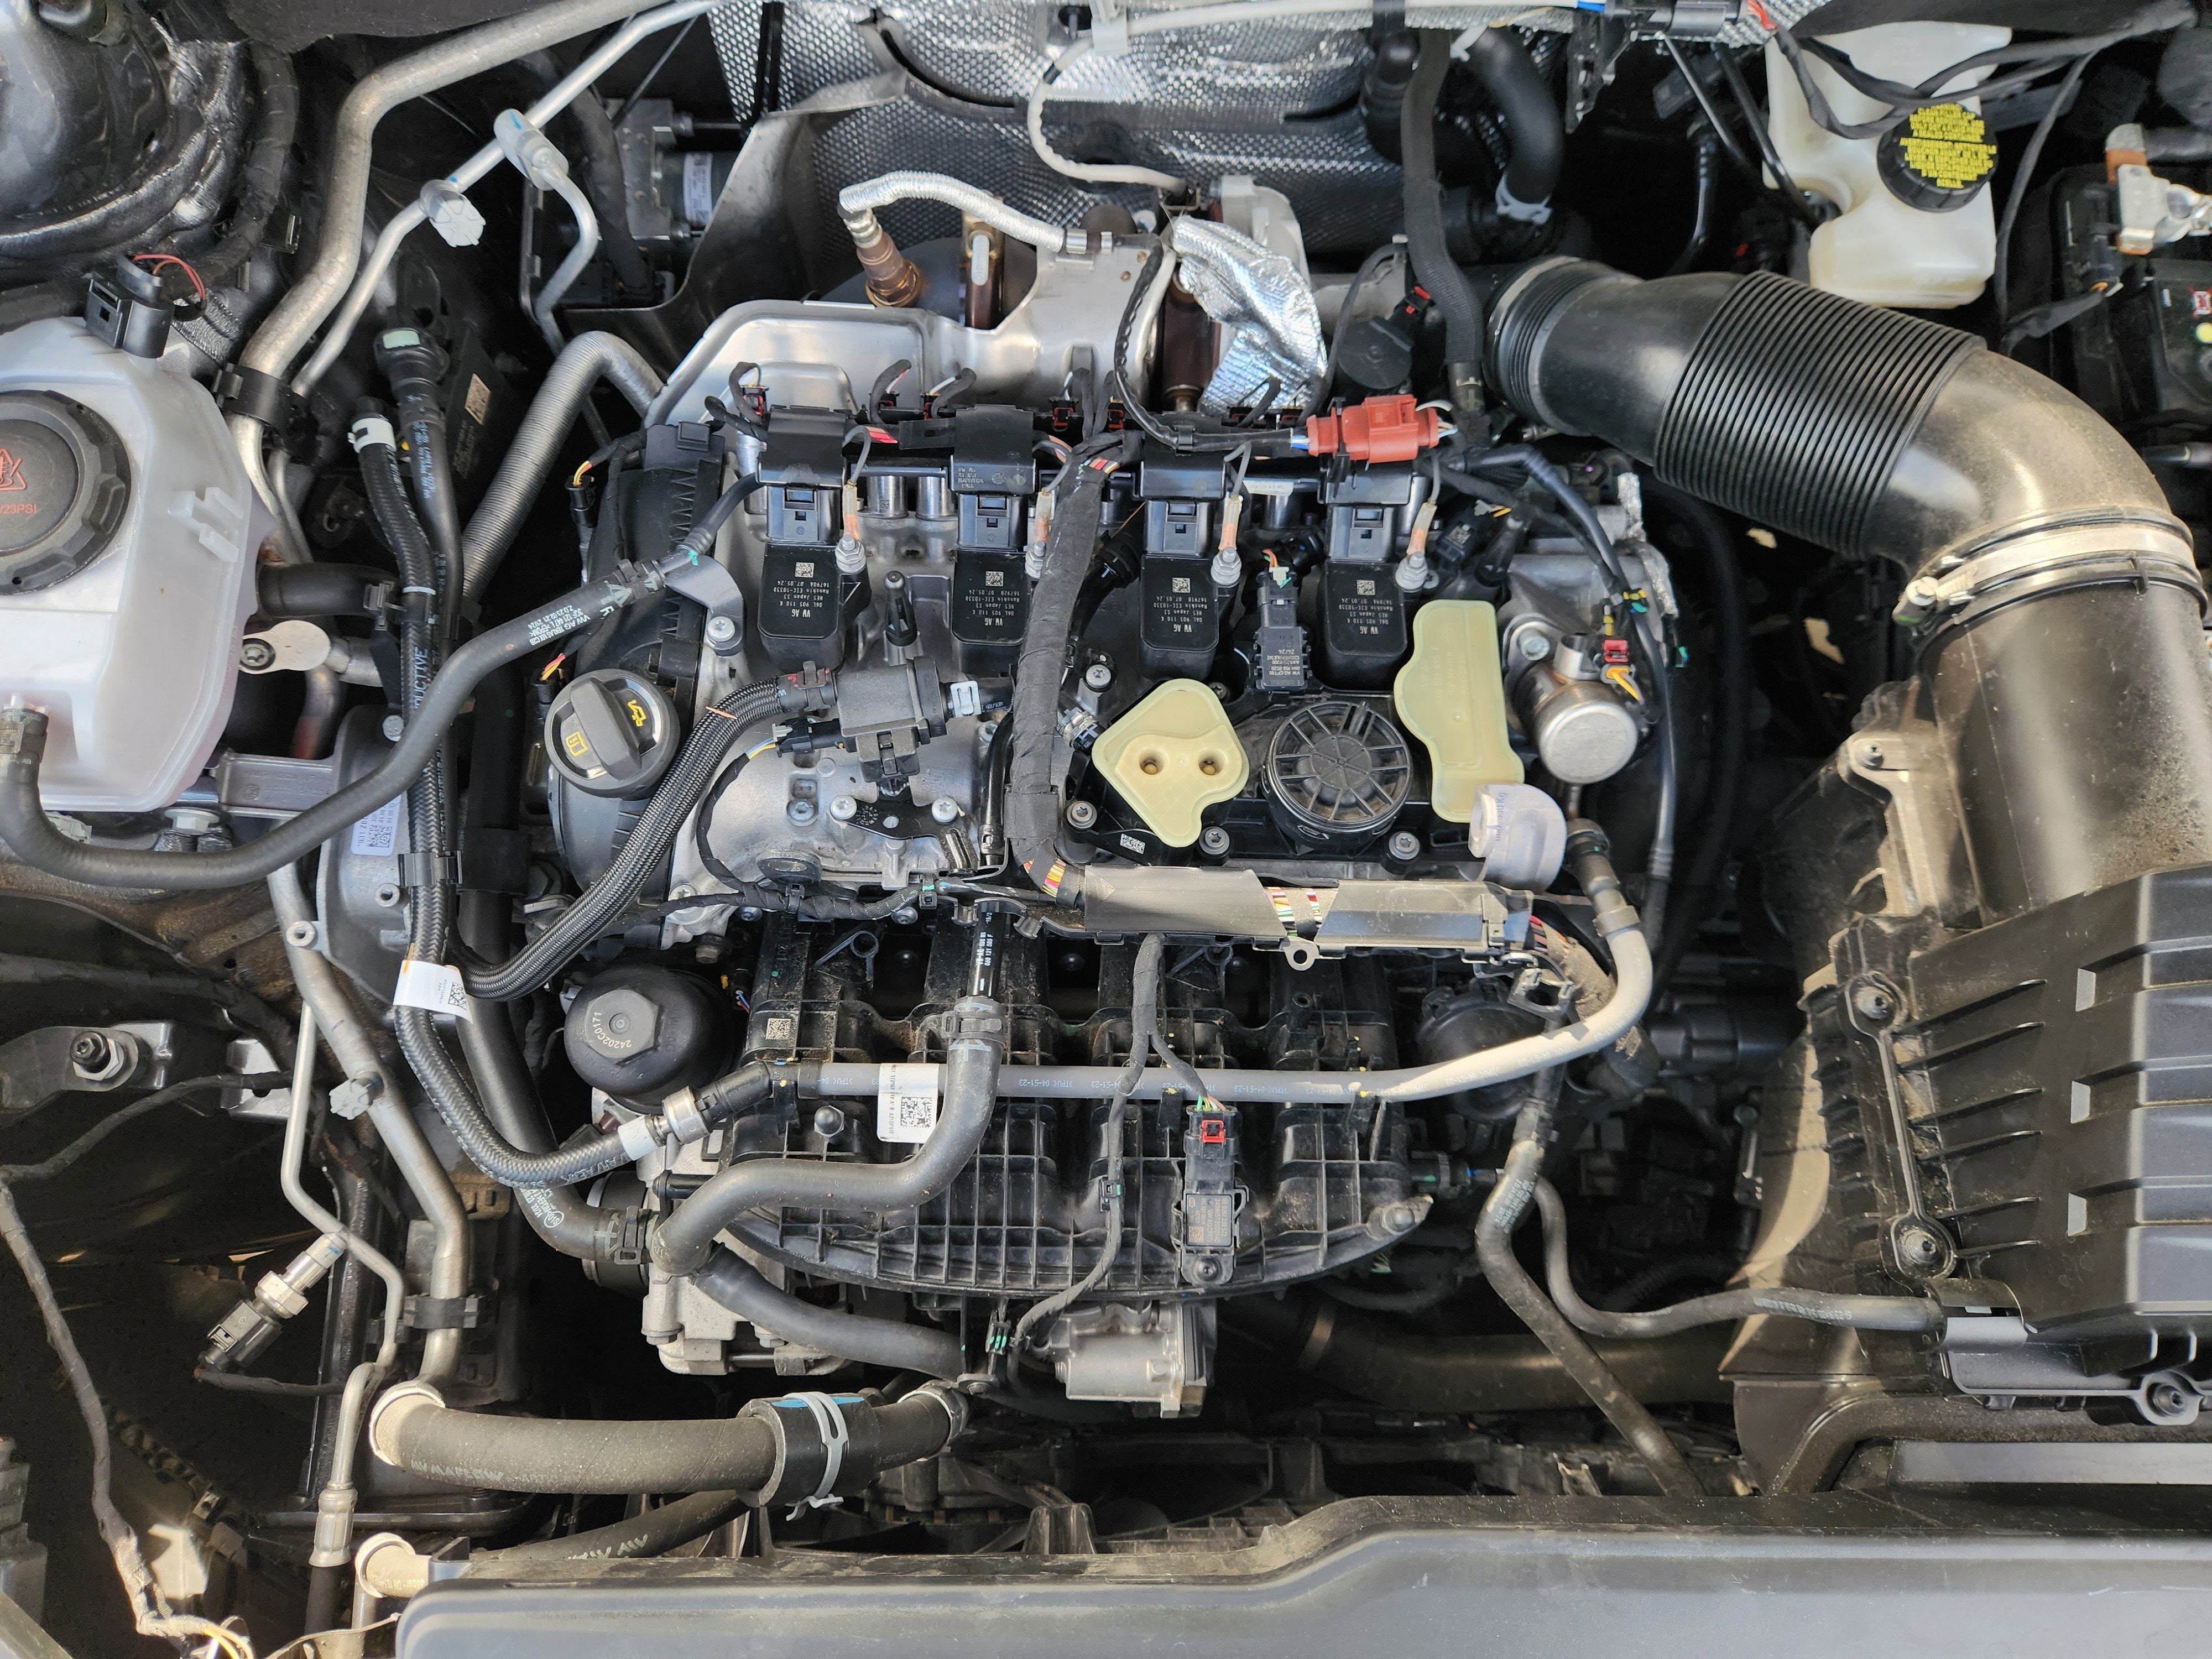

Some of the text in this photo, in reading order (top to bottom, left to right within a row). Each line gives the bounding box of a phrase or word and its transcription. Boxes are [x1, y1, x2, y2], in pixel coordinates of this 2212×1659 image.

[575, 613, 591, 625] VW
[791, 609, 811, 618] VW AG
[563, 620, 577, 631] AG
[545, 625, 565, 639] TEKLAS
[592, 1012, 632, 1049] 24202C0171
[1019, 1079, 1050, 1087] 04-51-23
